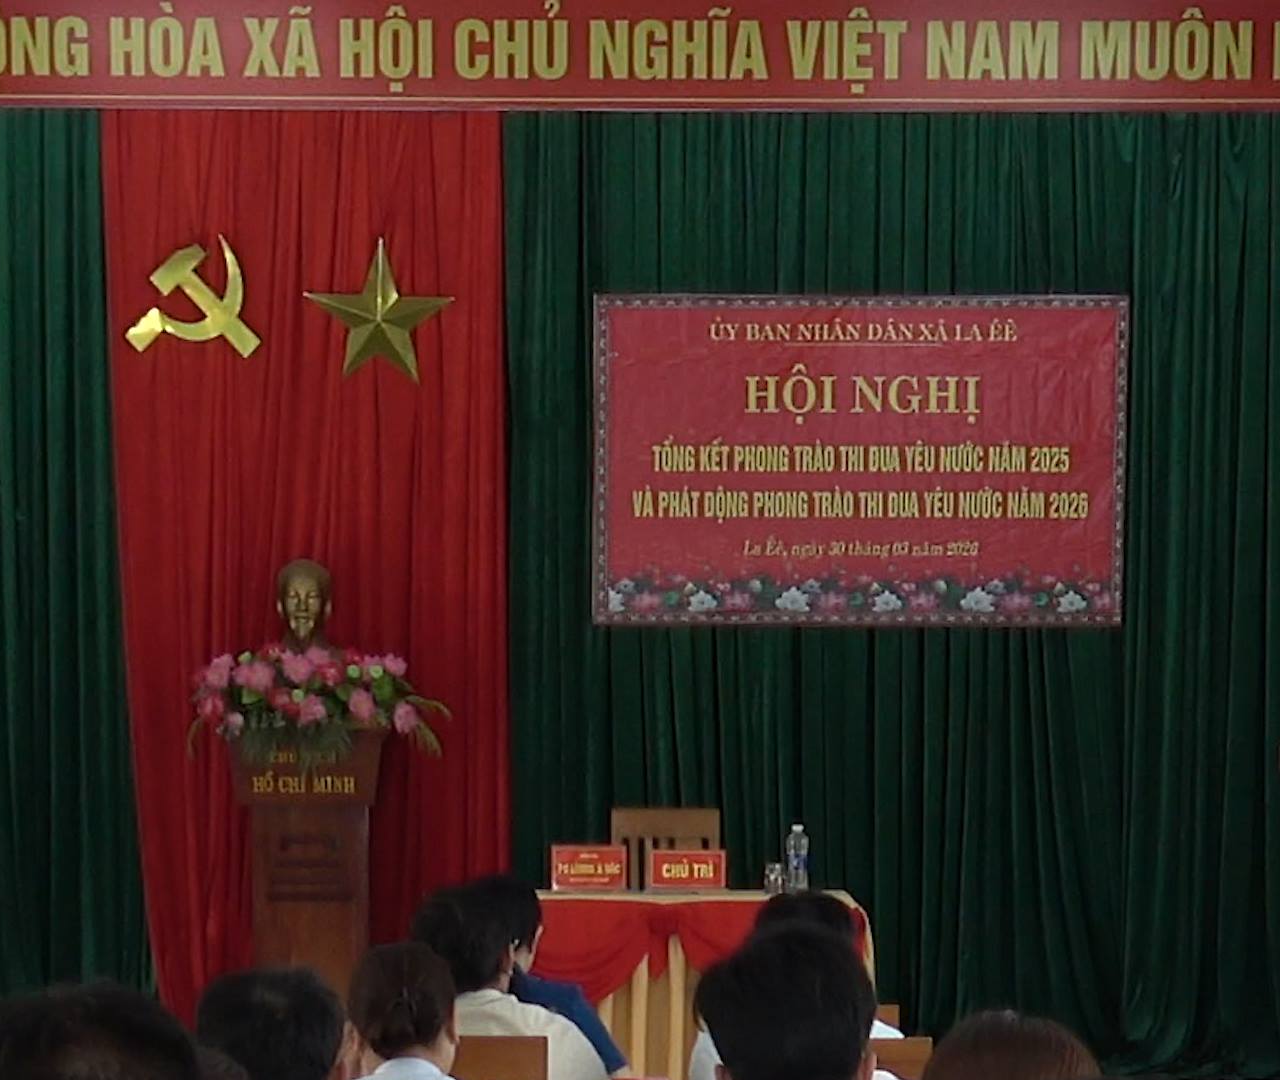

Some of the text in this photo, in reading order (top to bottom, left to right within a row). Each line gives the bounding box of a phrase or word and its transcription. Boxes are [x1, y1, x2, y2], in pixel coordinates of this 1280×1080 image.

[110, 2, 222, 77] HÒA
[244, 6, 320, 77] XÃ
[340, 6, 432, 92] HỘI
[455, 0, 568, 79] CHỦ
[590, 8, 768, 80] NGHĨA
[787, 7, 908, 94] VIỆT
[927, 21, 1058, 80] NAM
[1080, 8, 1252, 81] MUÔN
[746, 323, 790, 341] BAN
[797, 318, 861, 341] NHÂN
[955, 324, 982, 341] LA
[745, 364, 980, 424] HỘI NGHỊ
[652, 435, 1069, 472] TỔNG KẾT PHONG TRÀO THI ĐUA YÊU NƯỚC NĂM 2025
[633, 485, 653, 517] VÀ
[658, 486, 700, 518] PHÁT
[704, 486, 748, 523] ĐỘNG
[753, 491, 808, 518] PHONG
[813, 486, 853, 518] TRÀO
[858, 491, 883, 518] THI
[924, 486, 954, 518] YÊU
[959, 486, 1002, 518] NƯỚC
[1007, 486, 1044, 518] NĂM
[1050, 492, 1088, 519] 2026
[313, 776, 355, 793] MINH
[662, 858, 689, 878] CHỦ
